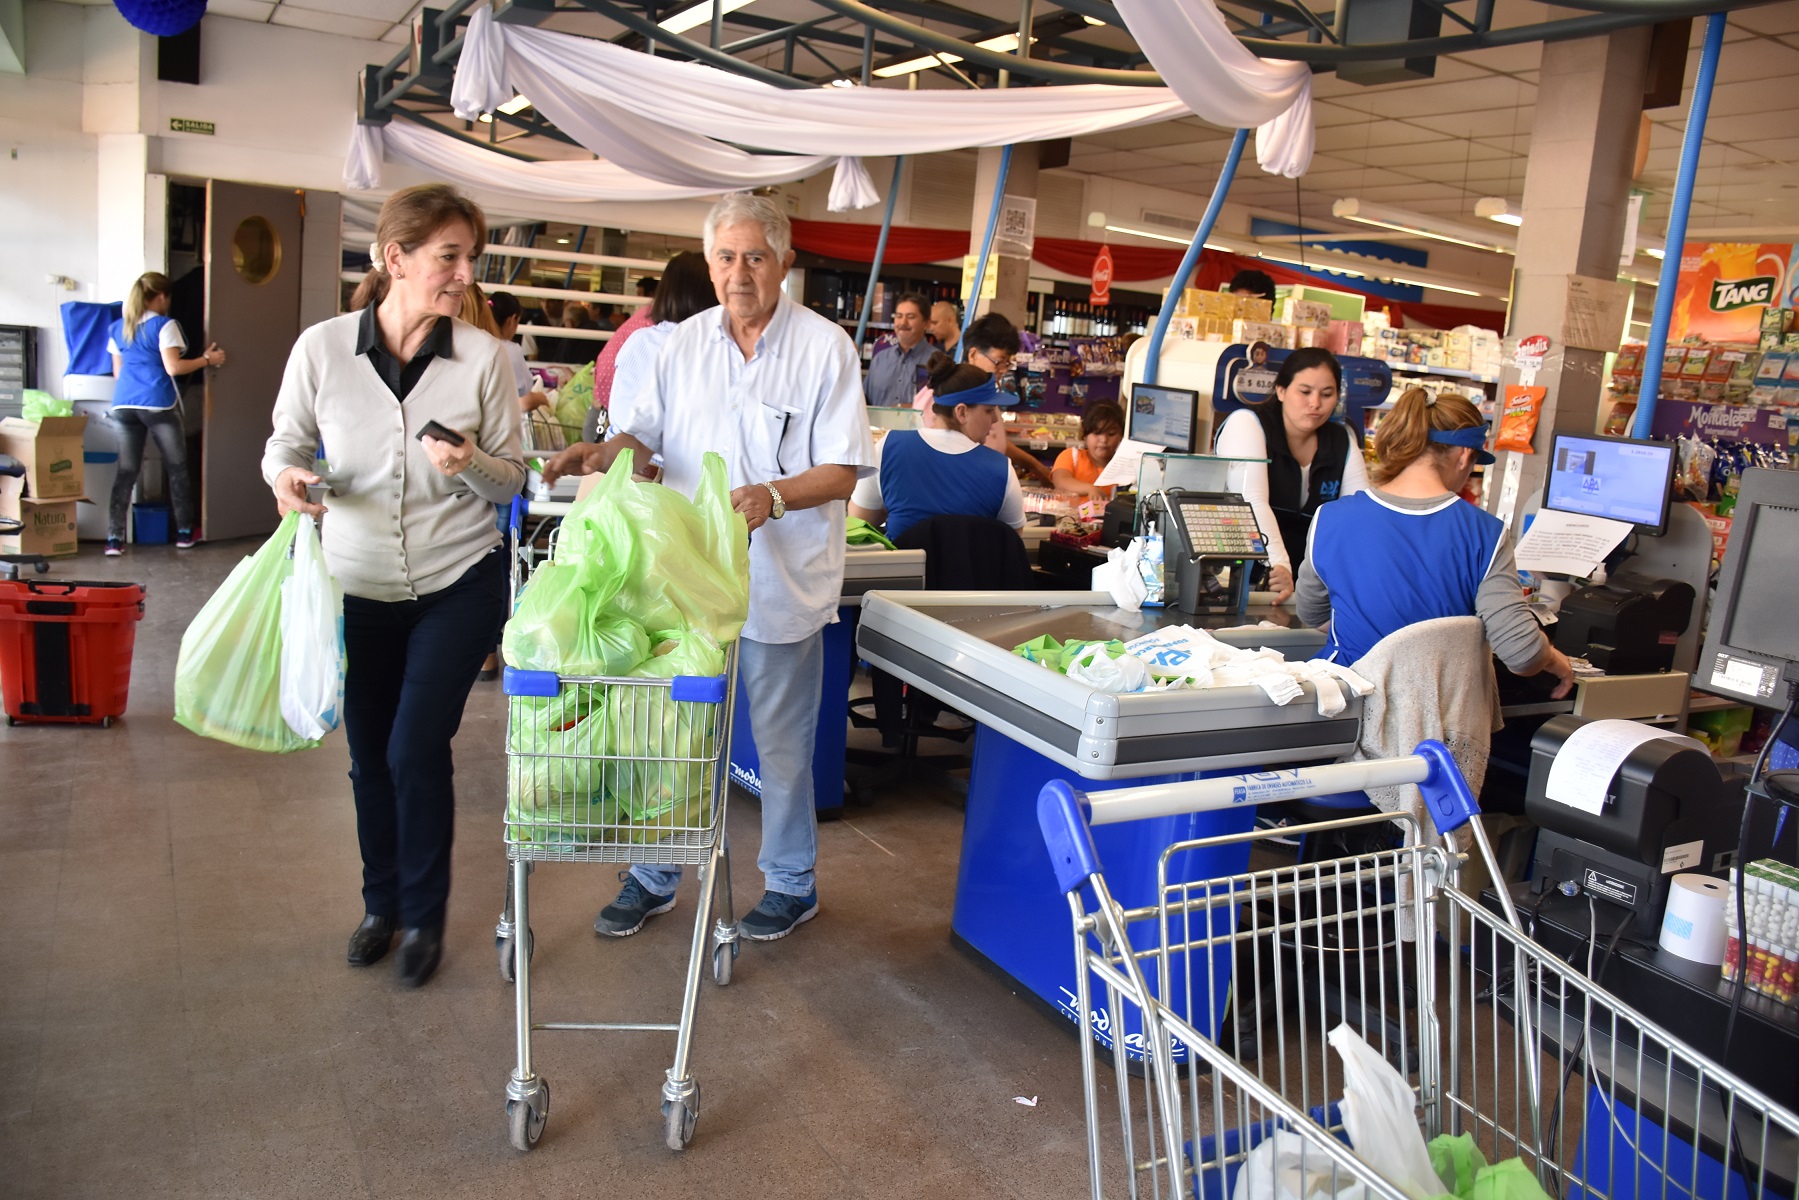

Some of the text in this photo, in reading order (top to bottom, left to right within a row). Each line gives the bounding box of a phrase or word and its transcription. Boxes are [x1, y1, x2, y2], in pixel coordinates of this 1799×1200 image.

[185, 121, 214, 131] SALIDA
[1715, 283, 1769, 309] TANG
[34, 512, 66, 526] Natura
